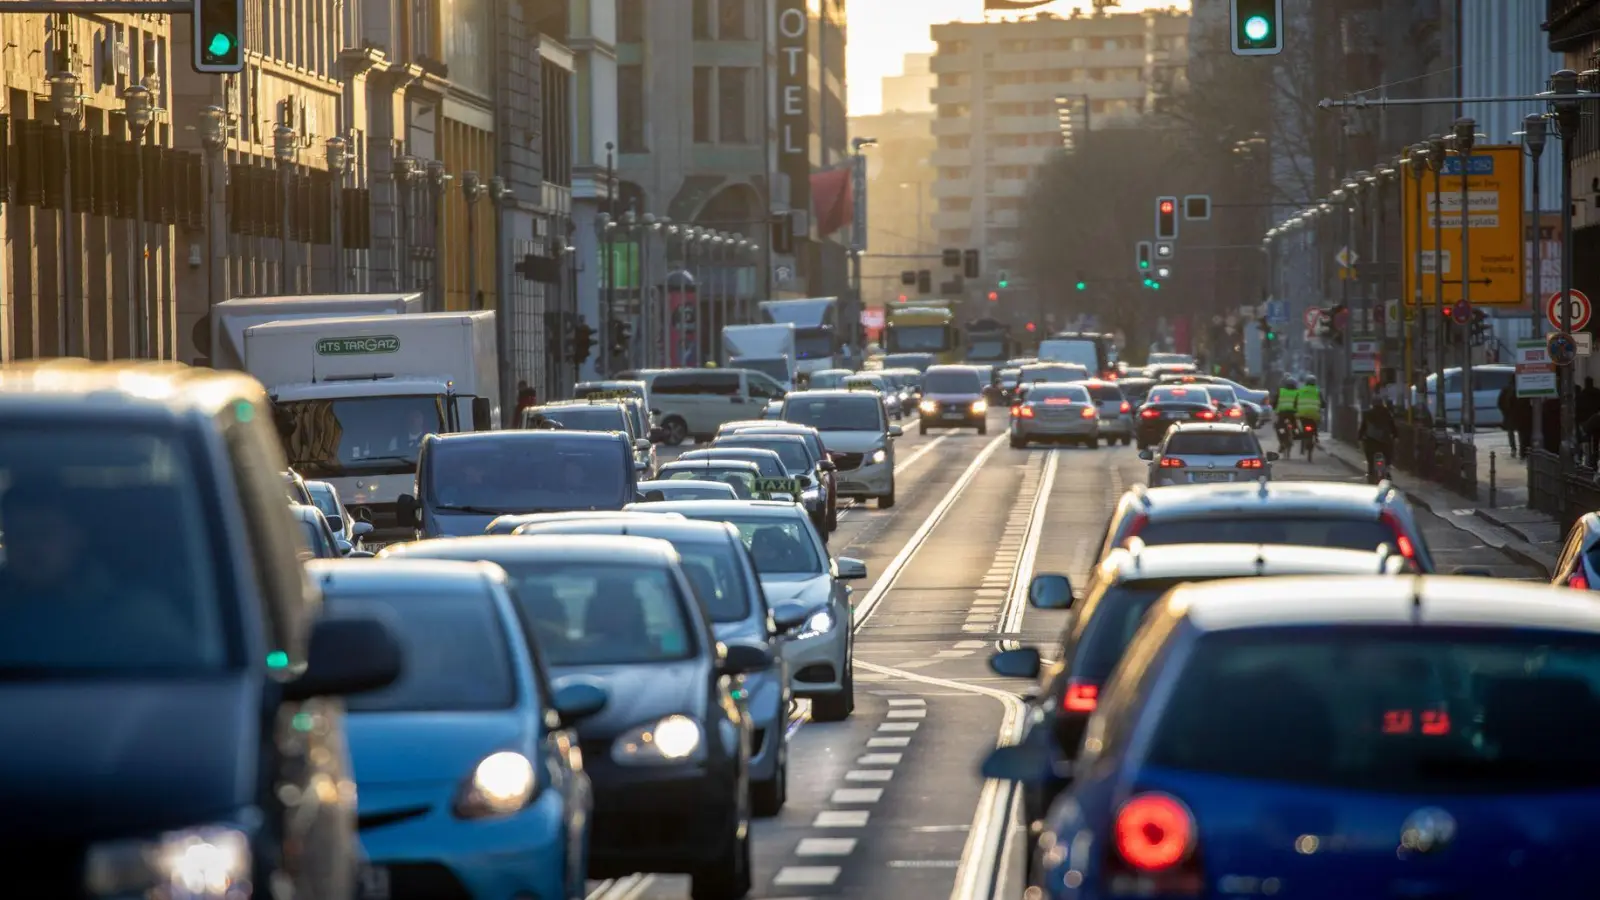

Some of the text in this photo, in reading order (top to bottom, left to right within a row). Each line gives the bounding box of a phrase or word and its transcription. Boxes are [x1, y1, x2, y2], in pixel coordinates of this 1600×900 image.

[780, 8, 805, 153] OTEL
[1447, 196, 1497, 206] Scnefeld
[1431, 218, 1496, 227] Aexanrplatz
[319, 339, 397, 352] HTS TARGATZ
[760, 480, 792, 490] TAXI
